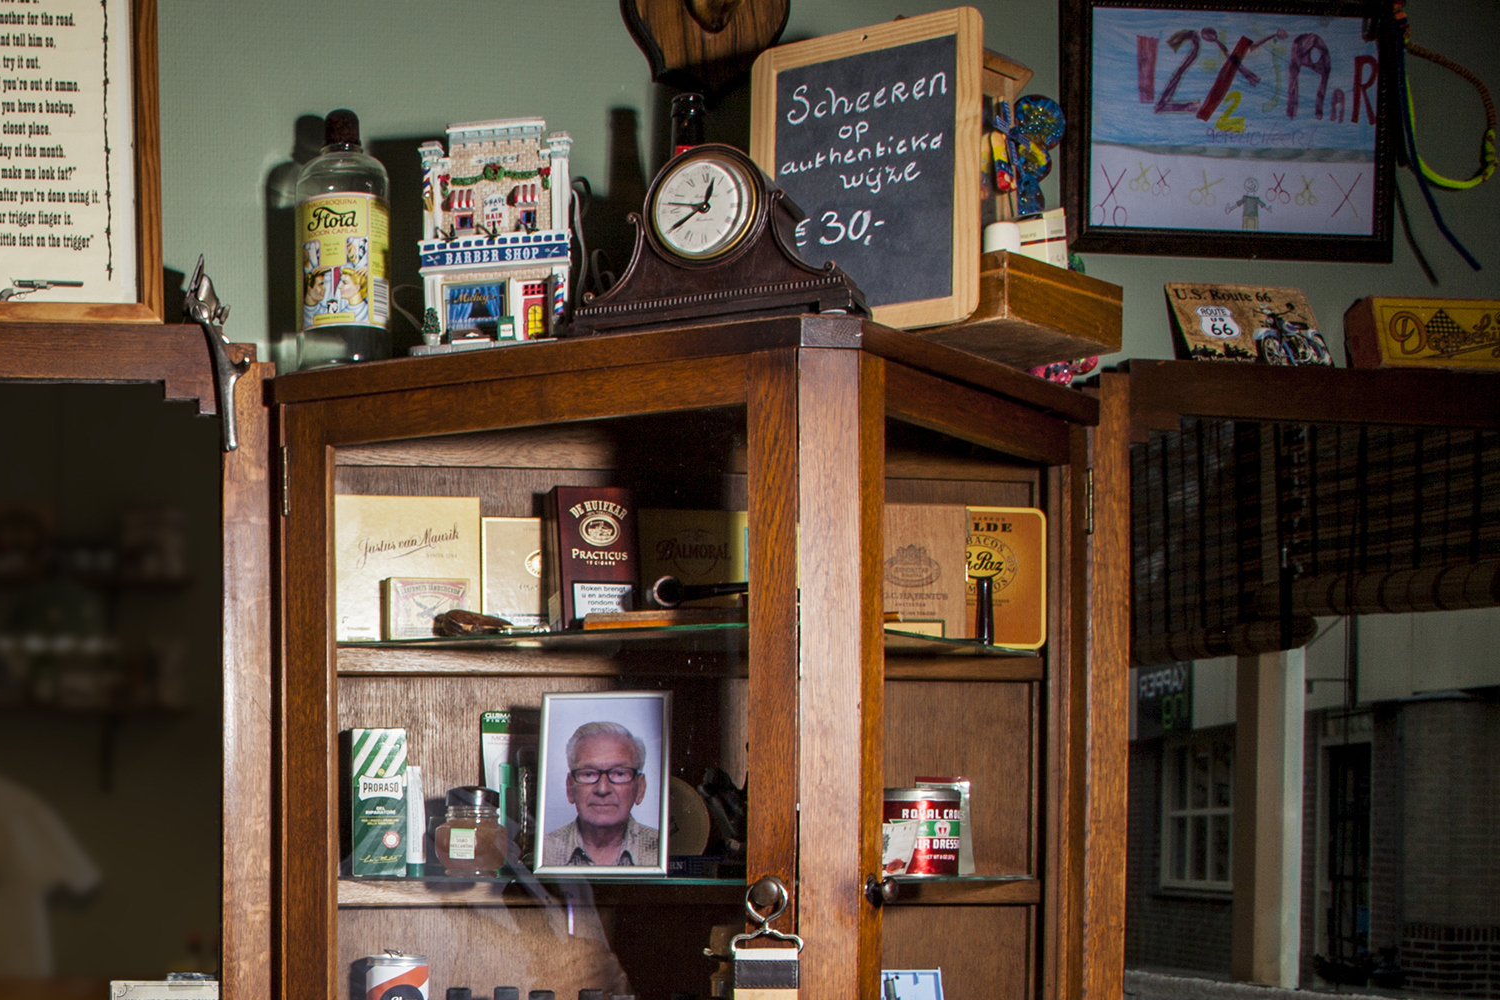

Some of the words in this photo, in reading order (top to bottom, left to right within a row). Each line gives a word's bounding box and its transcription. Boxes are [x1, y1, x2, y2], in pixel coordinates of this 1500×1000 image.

[27, 11, 39, 26] for
[41, 12, 53, 26] the
[56, 12, 76, 27] road.
[1, 101, 15, 116] you
[18, 99, 36, 113] have
[38, 102, 43, 114] a
[45, 99, 76, 118] backup.
[837, 120, 870, 143] op
[839, 160, 922, 195] wijze
[8, 210, 36, 228] trigger
[38, 210, 62, 228] finger
[64, 211, 73, 226] is.
[485, 212, 503, 221] HAIR
[445, 247, 499, 266] BARBER
[504, 245, 540, 262] SHOP
[1173, 287, 1208, 301] U.S.
[1209, 288, 1252, 304] Route
[1254, 290, 1272, 304] 66
[1198, 307, 1227, 317] ROUTE
[1212, 322, 1235, 338] 66
[568, 503, 586, 519] DE
[421, 521, 460, 546] Maurik
[571, 547, 629, 562] PRACTICUS
[973, 550, 1006, 572] Paz
[362, 782, 399, 794] PRORASO
